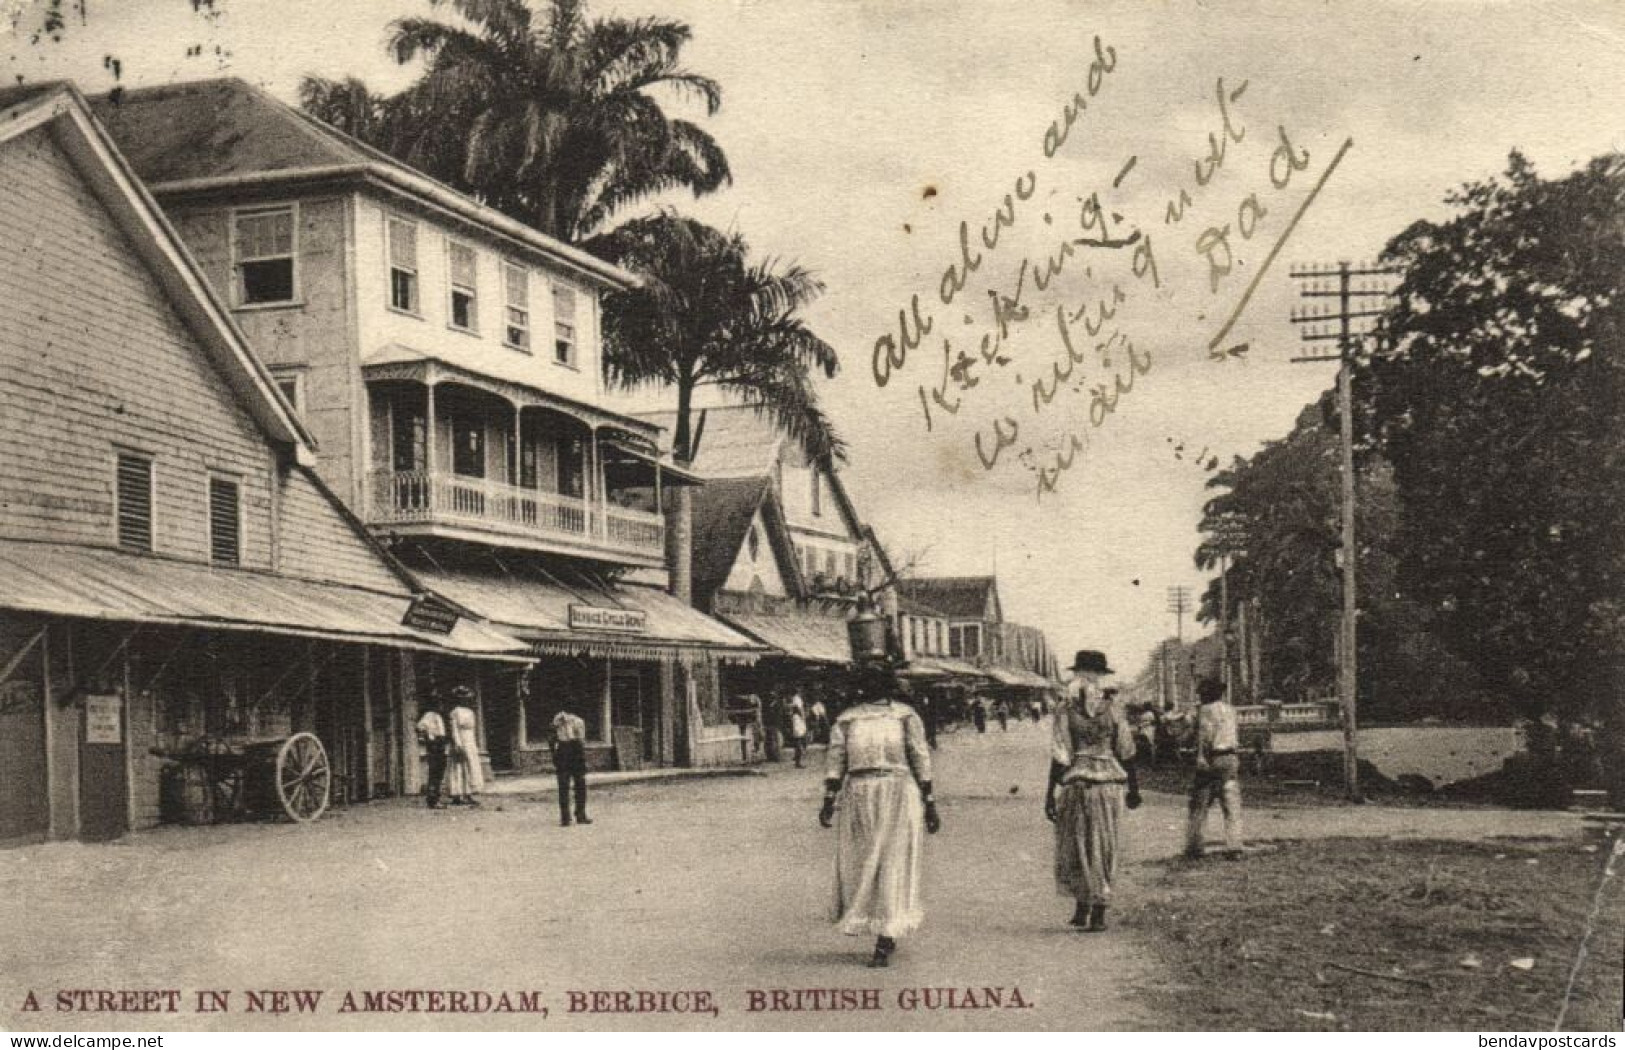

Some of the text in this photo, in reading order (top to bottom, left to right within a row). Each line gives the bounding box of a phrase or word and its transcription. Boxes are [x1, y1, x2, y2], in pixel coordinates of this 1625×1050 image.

[873, 294, 933, 387] all
[1043, 35, 1116, 158] and
[1195, 125, 1310, 294] Dad
